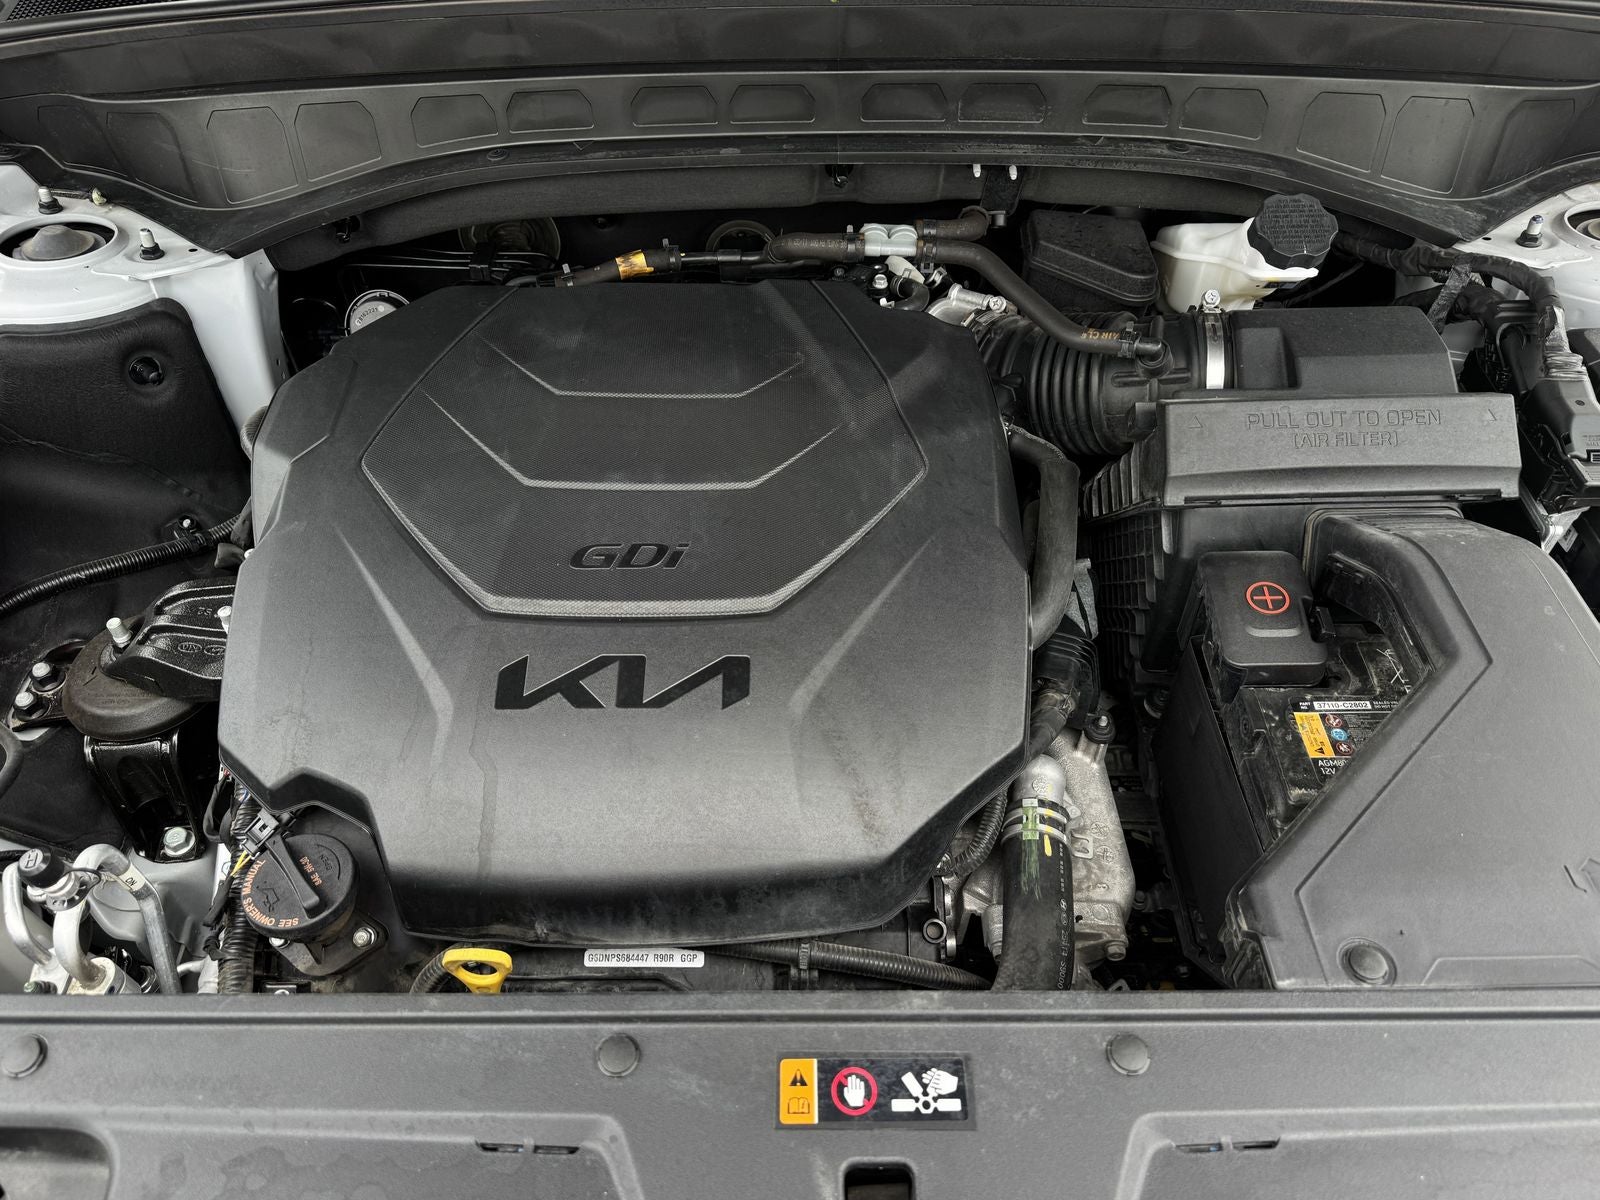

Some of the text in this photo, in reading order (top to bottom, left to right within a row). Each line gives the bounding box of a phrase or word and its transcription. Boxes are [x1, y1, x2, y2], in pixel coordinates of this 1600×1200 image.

[1247, 408, 1442, 430] PULL OUT TO OPEN
[1294, 430, 1399, 449] (AIR FILTER)
[569, 542, 692, 570] GDi
[494, 653, 751, 710] KIA
[1320, 767, 1336, 775] 12V
[241, 860, 266, 895] MANUAL
[310, 872, 323, 887] SAE
[278, 917, 299, 928] SEE
[680, 953, 698, 963] GGP
